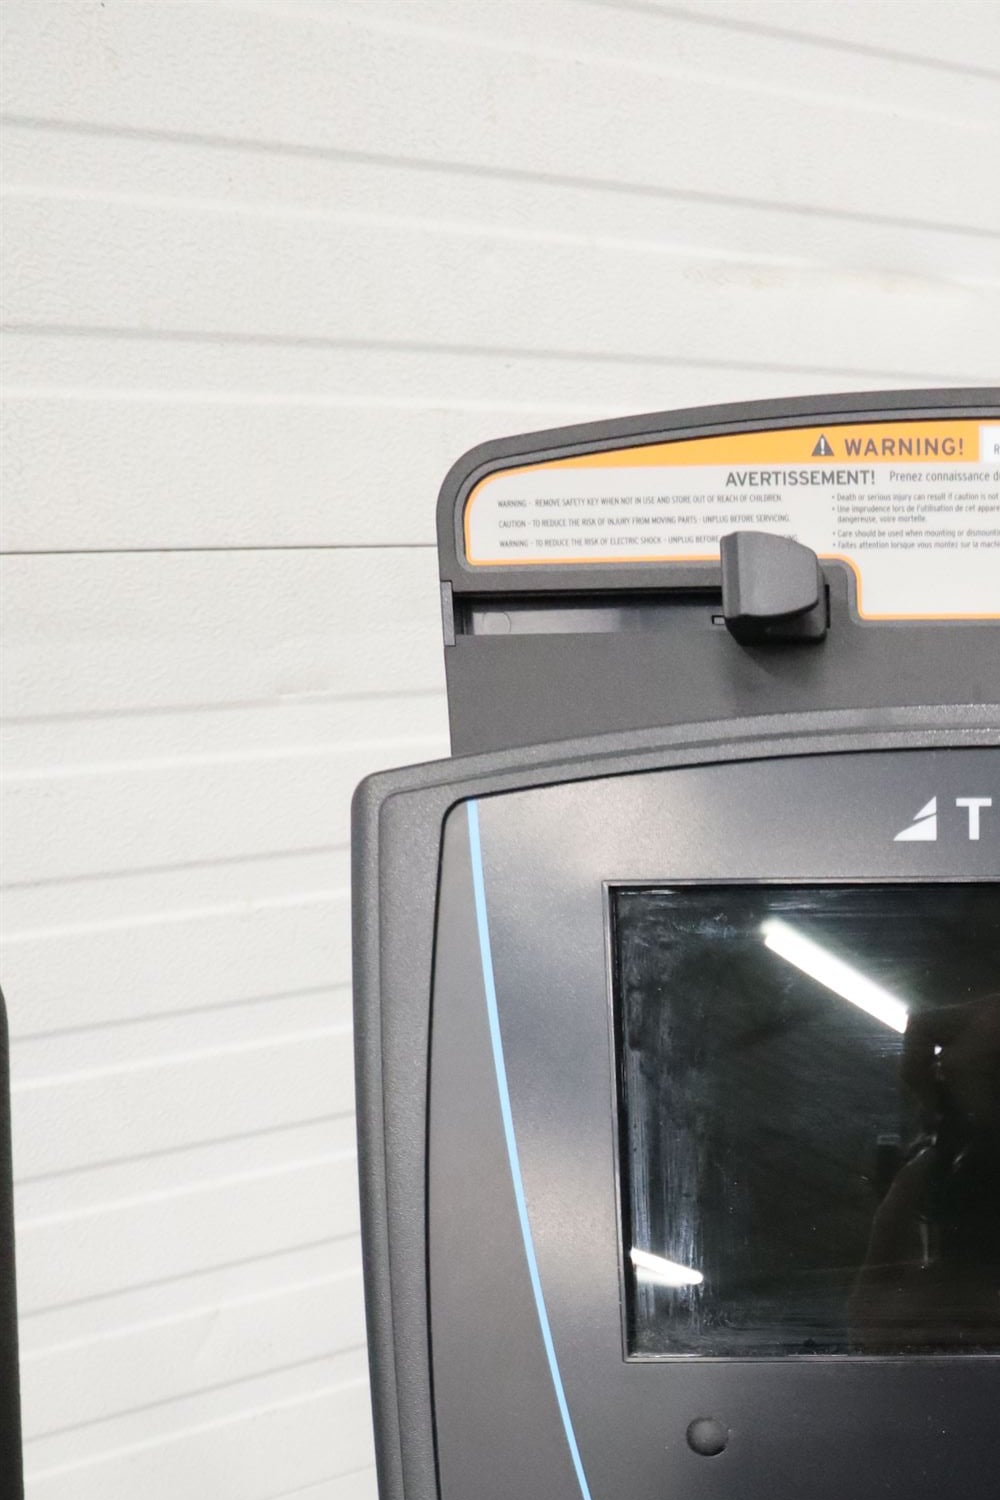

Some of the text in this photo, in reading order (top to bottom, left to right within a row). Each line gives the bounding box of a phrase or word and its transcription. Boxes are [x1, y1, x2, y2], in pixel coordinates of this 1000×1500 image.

[844, 438, 964, 456] WARNING!
[725, 470, 875, 486] AVERTISSEMENT!
[890, 471, 922, 482] Prenez
[926, 471, 990, 482] connaissance
[498, 499, 527, 507] WARNING
[535, 499, 560, 507] REMOVE
[562, 498, 585, 506] SAFETY
[600, 497, 619, 505] WHEN
[620, 497, 632, 505] NOT
[656, 496, 670, 504] AND
[672, 496, 691, 504] STORE
[693, 496, 705, 504] OUT
[717, 495, 738, 503] REACH
[498, 520, 526, 528] CAUTION
[542, 519, 566, 527] REDUCE
[582, 518, 596, 526] RISK
[607, 518, 630, 526] INJURY
[632, 517, 650, 525] FROM
[652, 517, 676, 525] MOVING
[678, 516, 697, 524] PARTS
[702, 516, 728, 524] UNPLUG
[730, 515, 754, 523] BEFORE
[500, 539, 528, 547] WARNING
[544, 538, 568, 546] REDUCE
[610, 537, 639, 545] ELECTRIC
[640, 536, 662, 544] SHOCK
[696, 535, 719, 543] BEFORE
